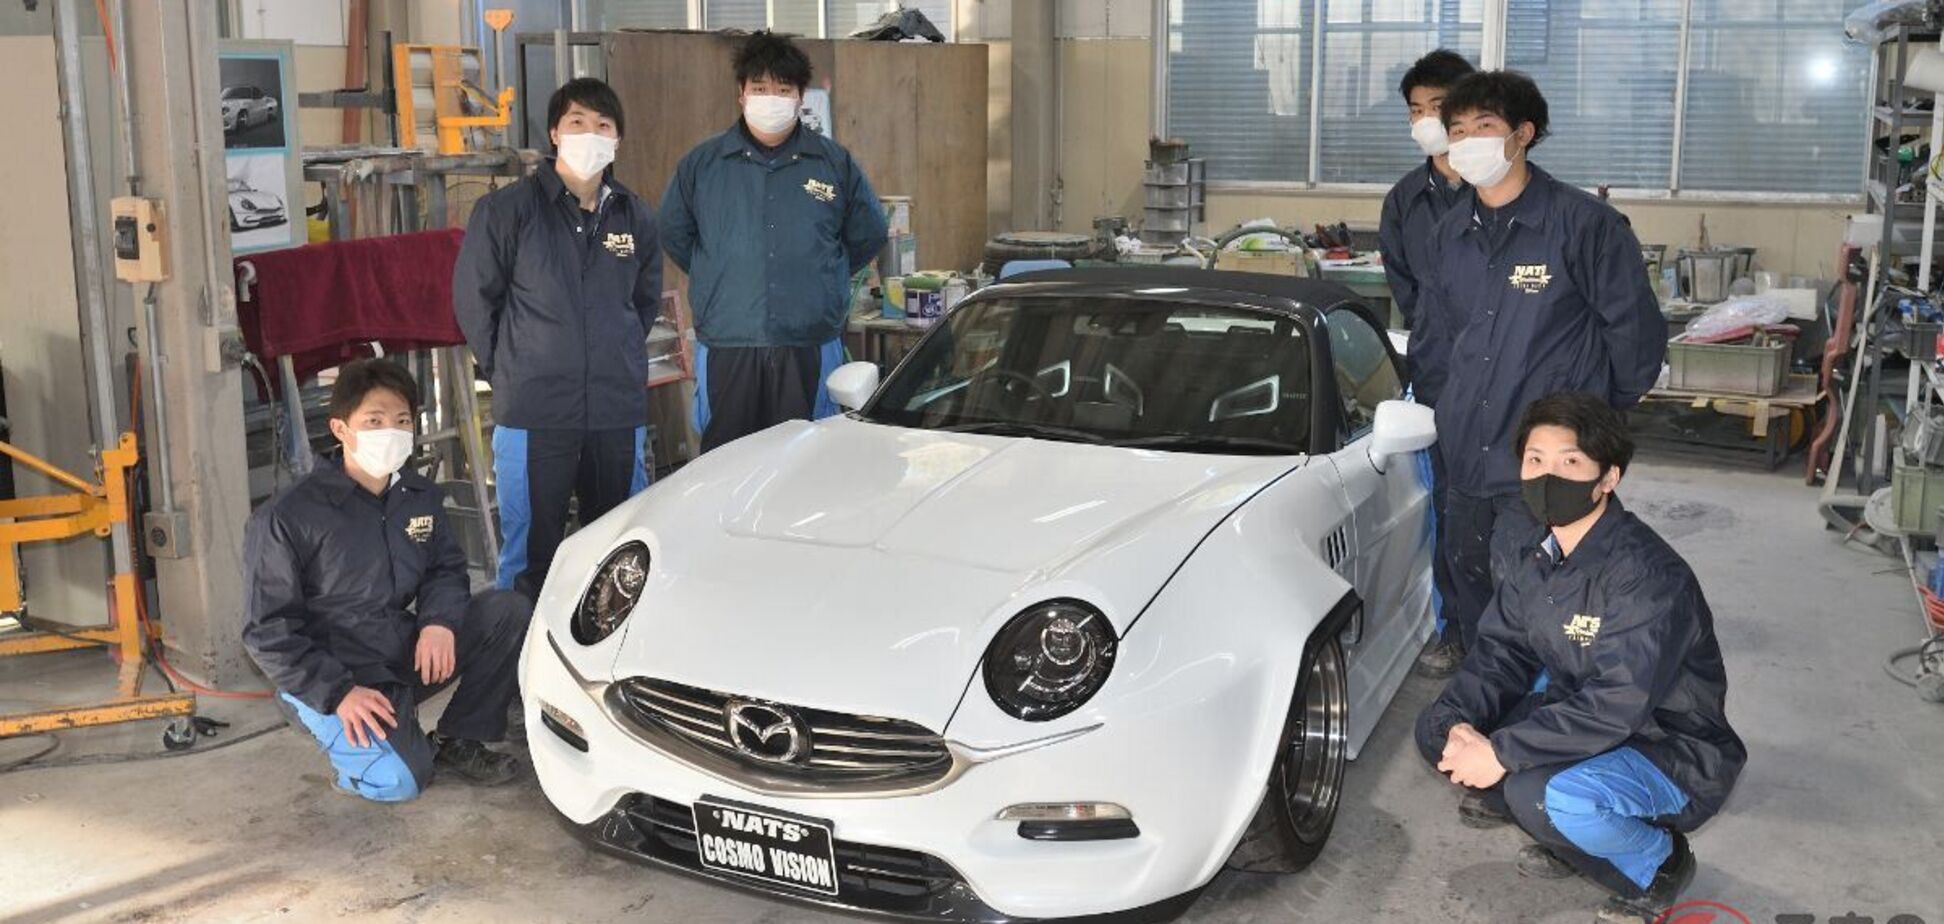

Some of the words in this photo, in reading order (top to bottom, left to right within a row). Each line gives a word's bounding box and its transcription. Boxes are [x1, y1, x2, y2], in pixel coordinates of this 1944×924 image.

[721, 809, 801, 842] NATS
[702, 833, 766, 872] COSMO
[769, 847, 832, 887] VISION
